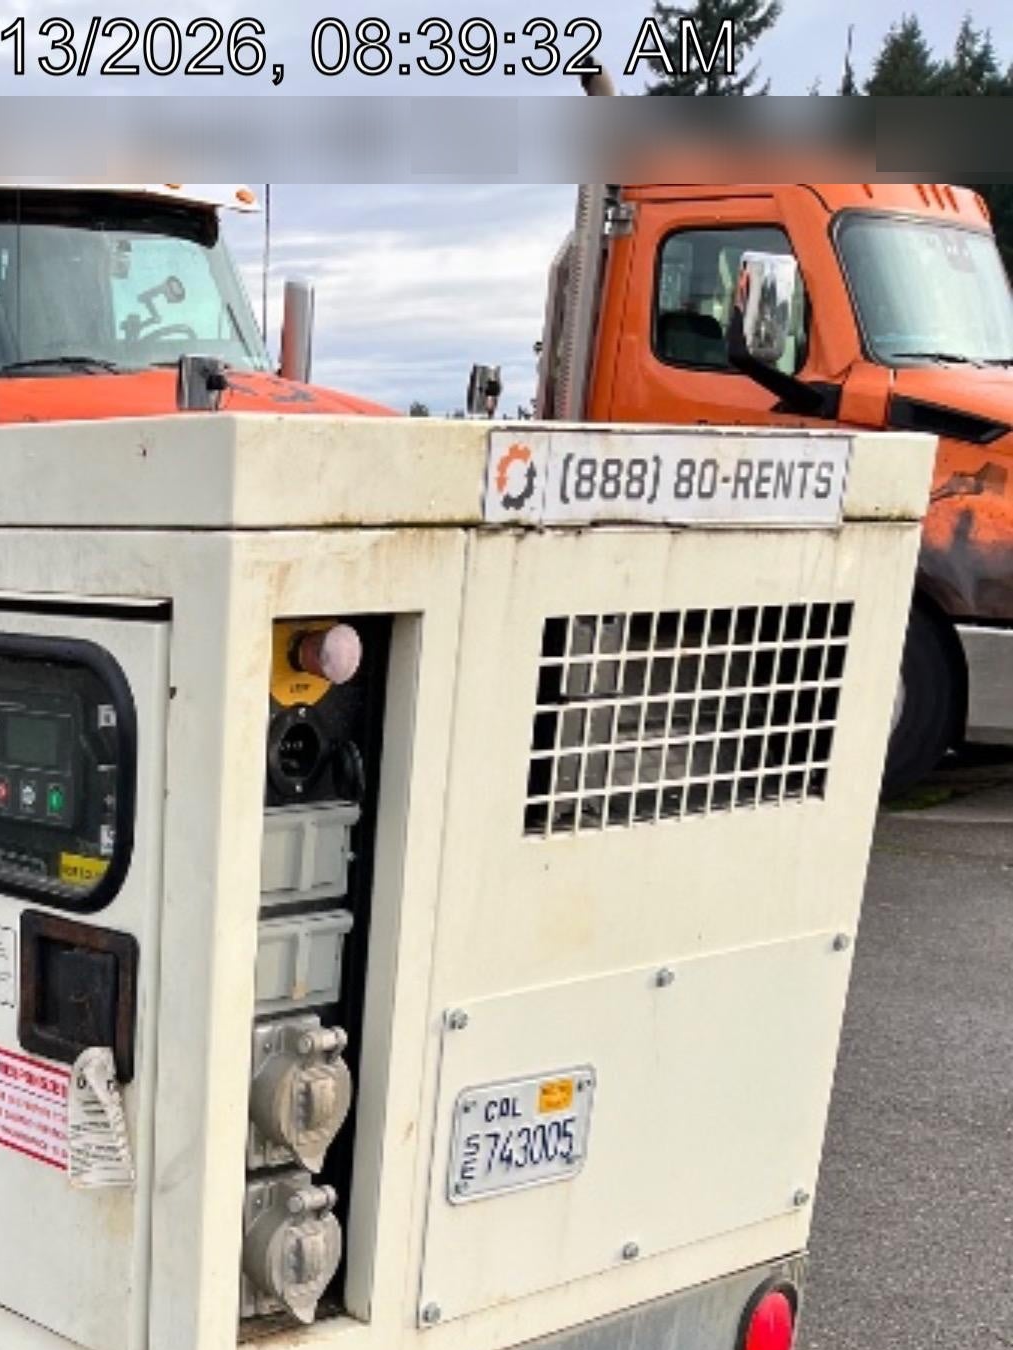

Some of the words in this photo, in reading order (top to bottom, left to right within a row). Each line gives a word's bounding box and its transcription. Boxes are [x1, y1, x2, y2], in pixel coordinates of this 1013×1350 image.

[559, 452, 662, 504] (888)
[673, 457, 835, 500] 80-RENTS
[484, 1116, 576, 1174] 743005
